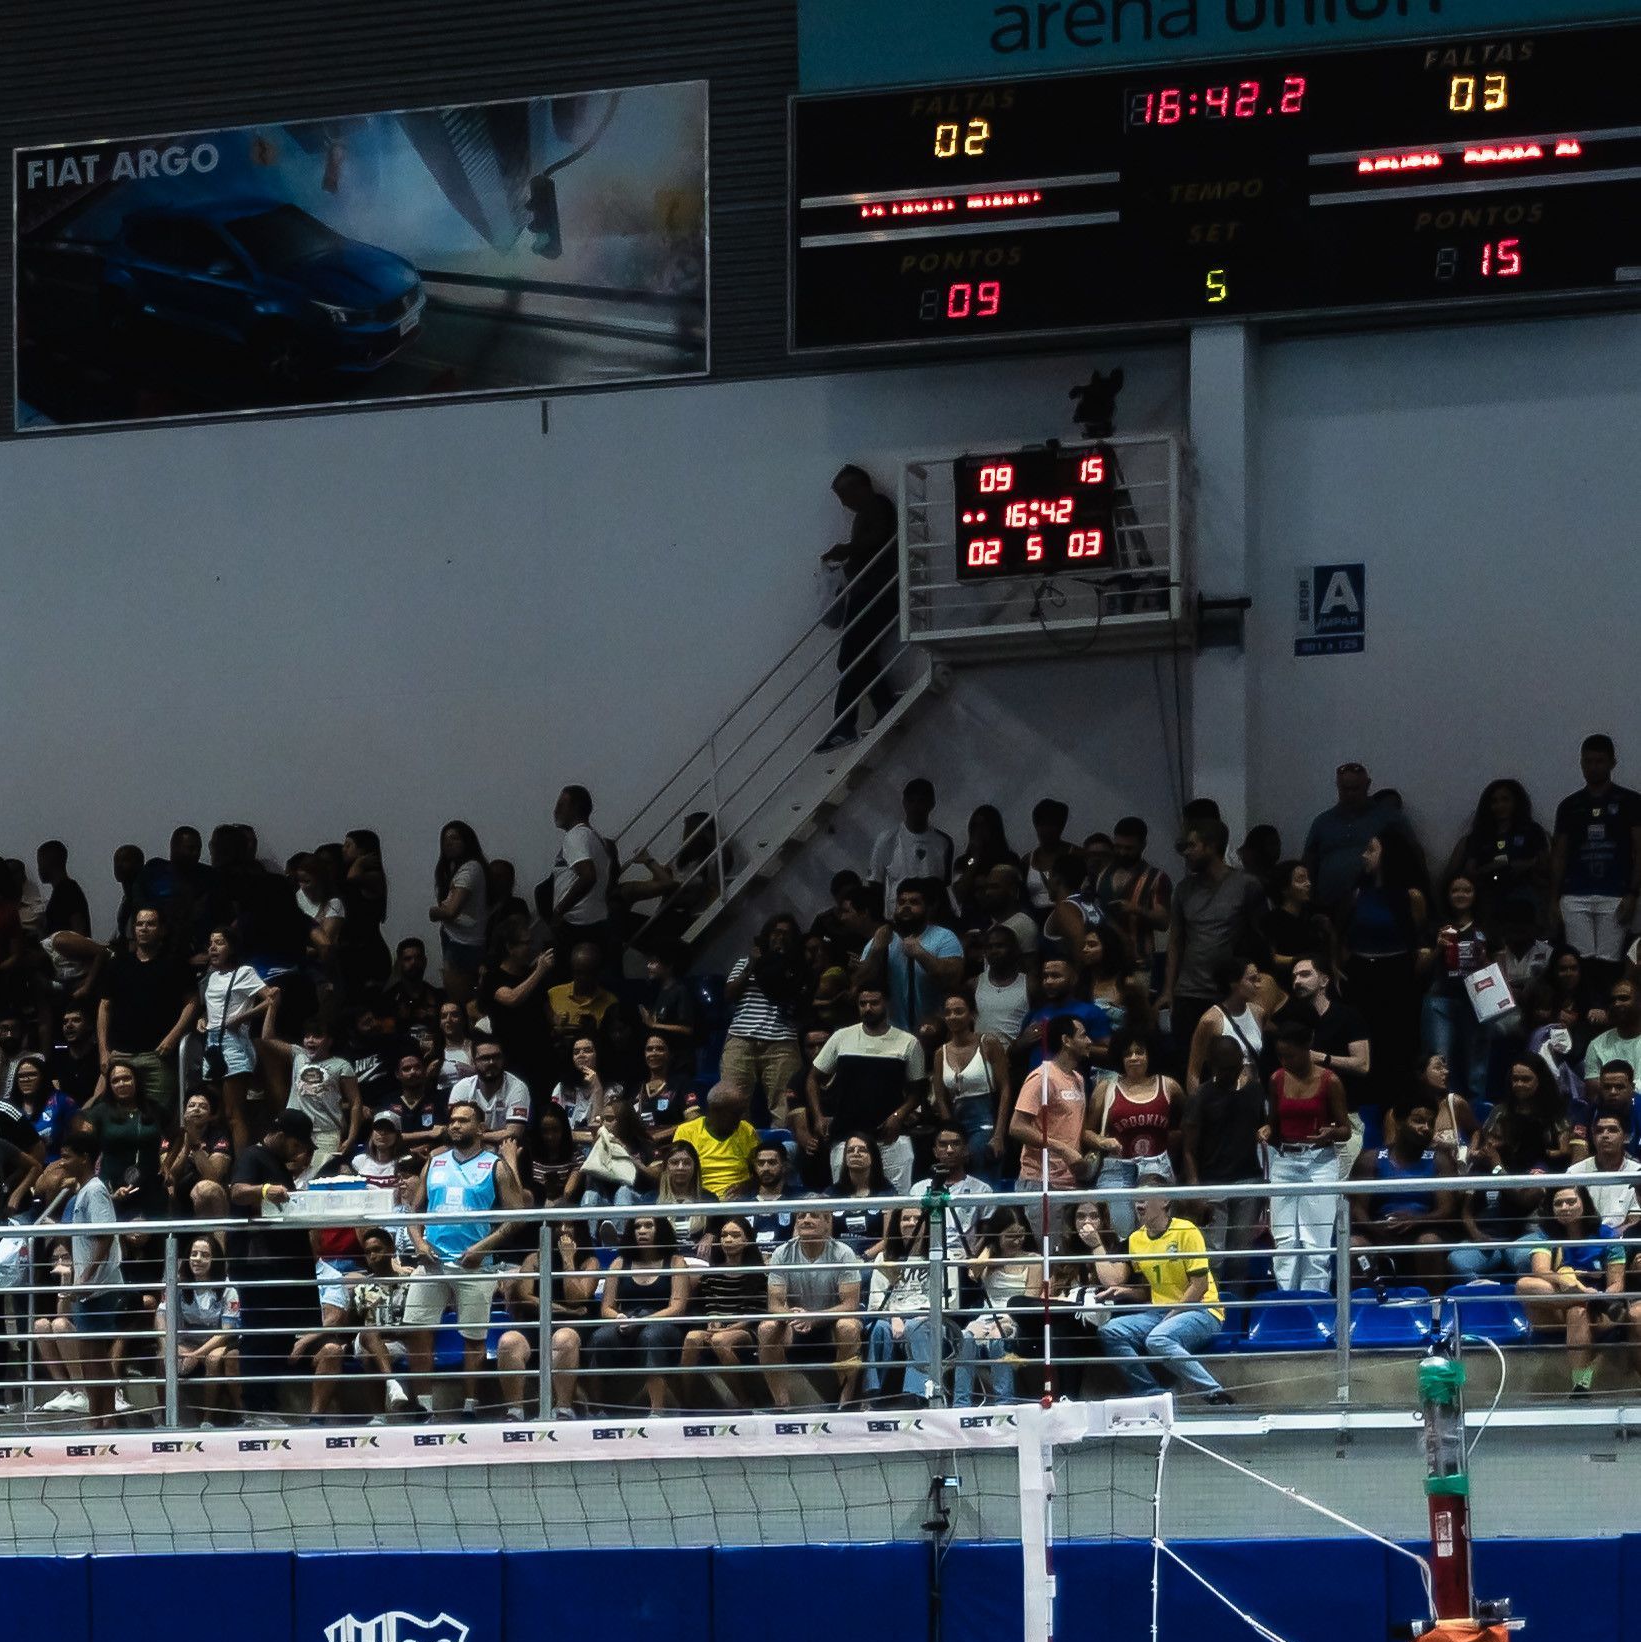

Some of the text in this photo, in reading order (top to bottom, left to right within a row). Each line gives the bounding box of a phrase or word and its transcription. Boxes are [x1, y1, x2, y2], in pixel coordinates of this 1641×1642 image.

[1422, 41, 1535, 70] FALTAS
[909, 88, 1015, 118] FALTAS
[1144, 73, 1309, 126] 16:42.2
[1448, 72, 1508, 112] 03
[933, 119, 992, 158] 02
[25, 142, 220, 190] FIAT ARGO
[1168, 179, 1264, 204] TEMPO
[1415, 203, 1545, 233] PONTOS
[1188, 221, 1239, 245] SET
[900, 247, 1022, 275] PONTOS
[1481, 239, 1522, 277] 15
[1205, 268, 1228, 303] 5
[947, 281, 1002, 319] 09
[980, 466, 1013, 493] 09
[1080, 458, 1103, 483] 15
[1005, 498, 1073, 528] 16:42
[968, 540, 1002, 566] 02
[1027, 536, 1042, 561] 5
[1068, 531, 1102, 557] 03
[1319, 571, 1359, 614] A
[413, 1432, 468, 1447] BET7K
[592, 1426, 649, 1441] BET7K
[774, 1422, 832, 1435] BET7K
[66, 1444, 119, 1457] BET7K
[238, 1438, 291, 1452] BET7K
